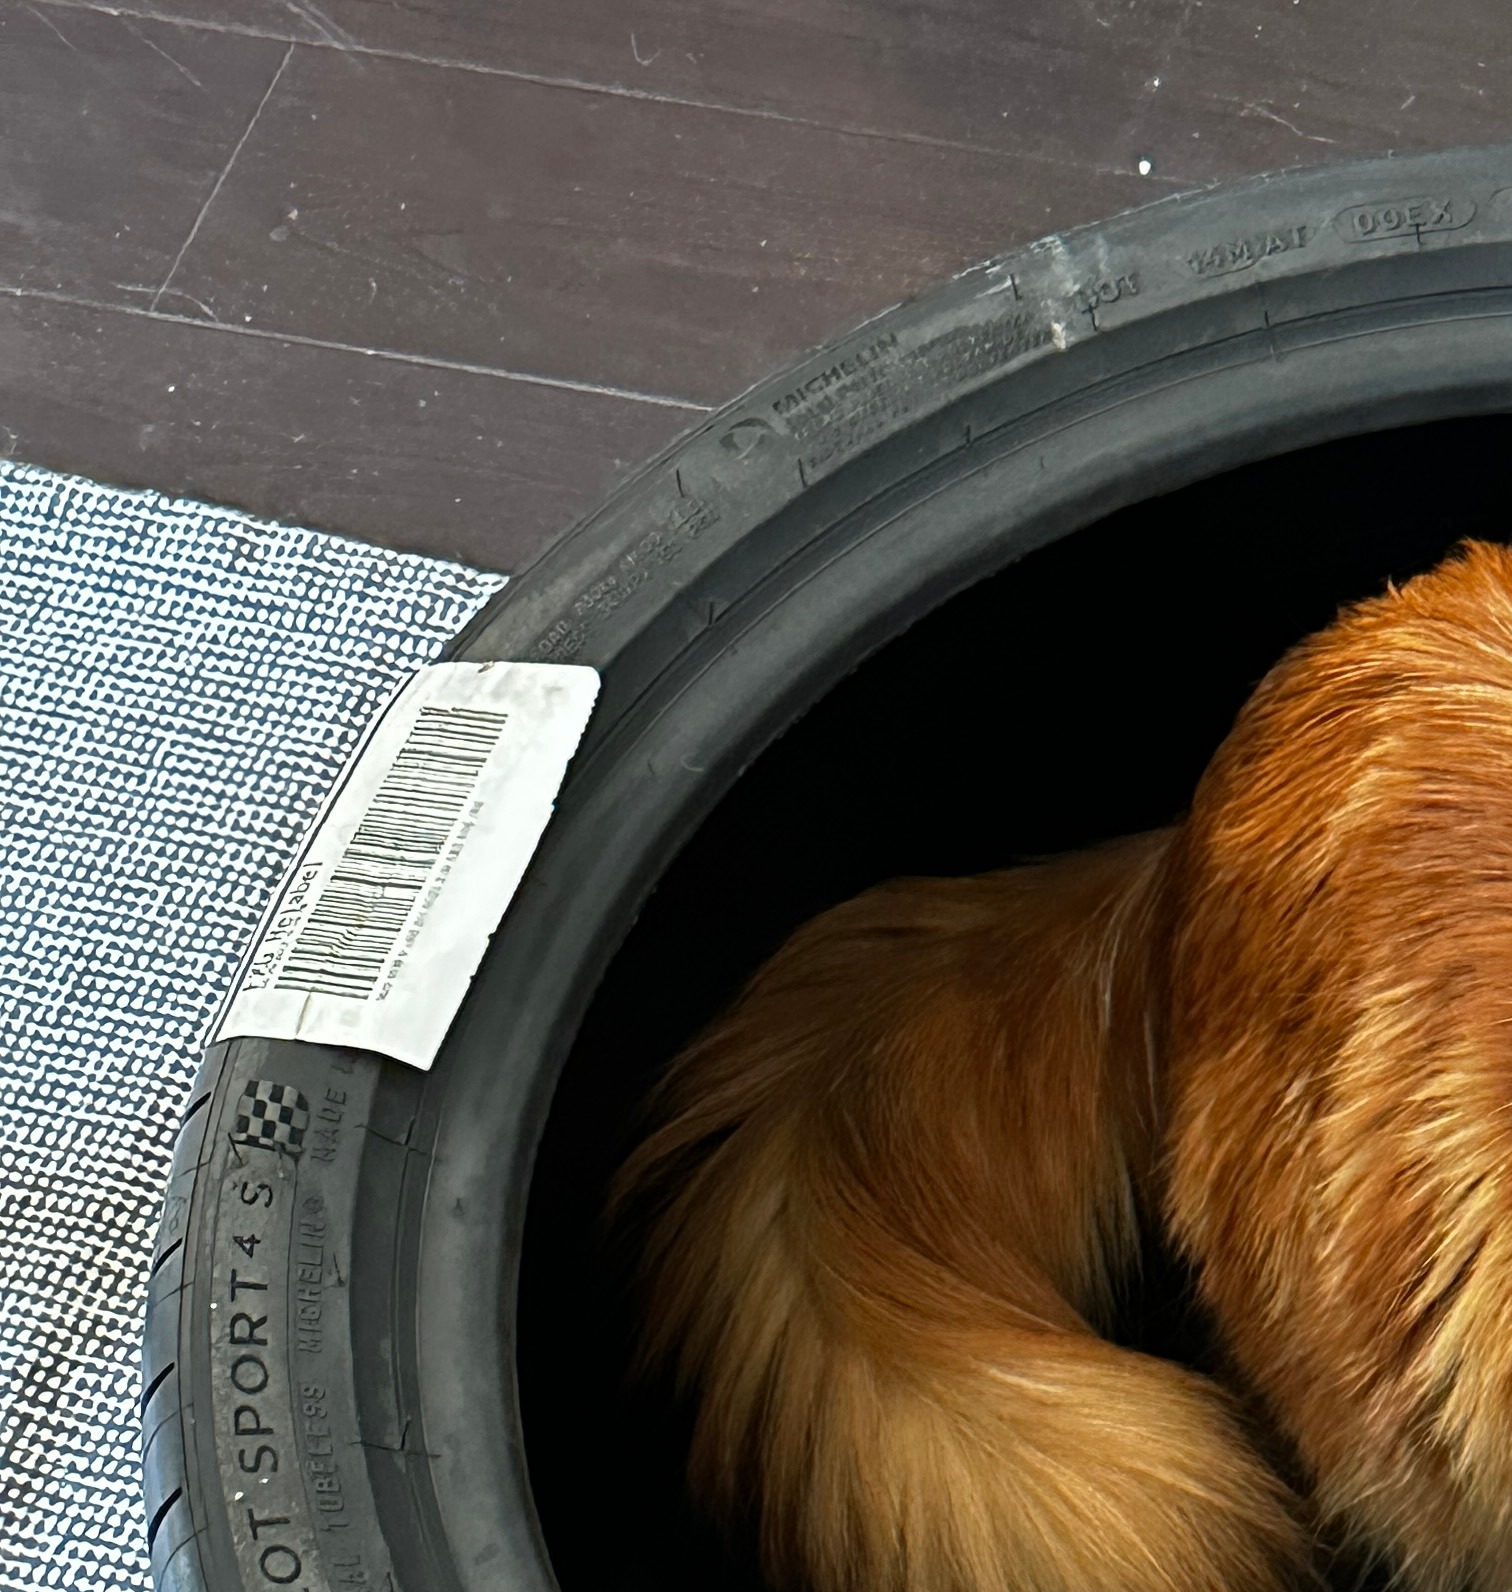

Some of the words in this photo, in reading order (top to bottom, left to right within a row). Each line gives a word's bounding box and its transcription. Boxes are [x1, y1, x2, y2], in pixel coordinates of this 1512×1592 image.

[771, 330, 902, 418] MICHELIN
[238, 1177, 277, 1209] S
[232, 1233, 262, 1259] 4
[227, 1259, 282, 1472] SPORT
